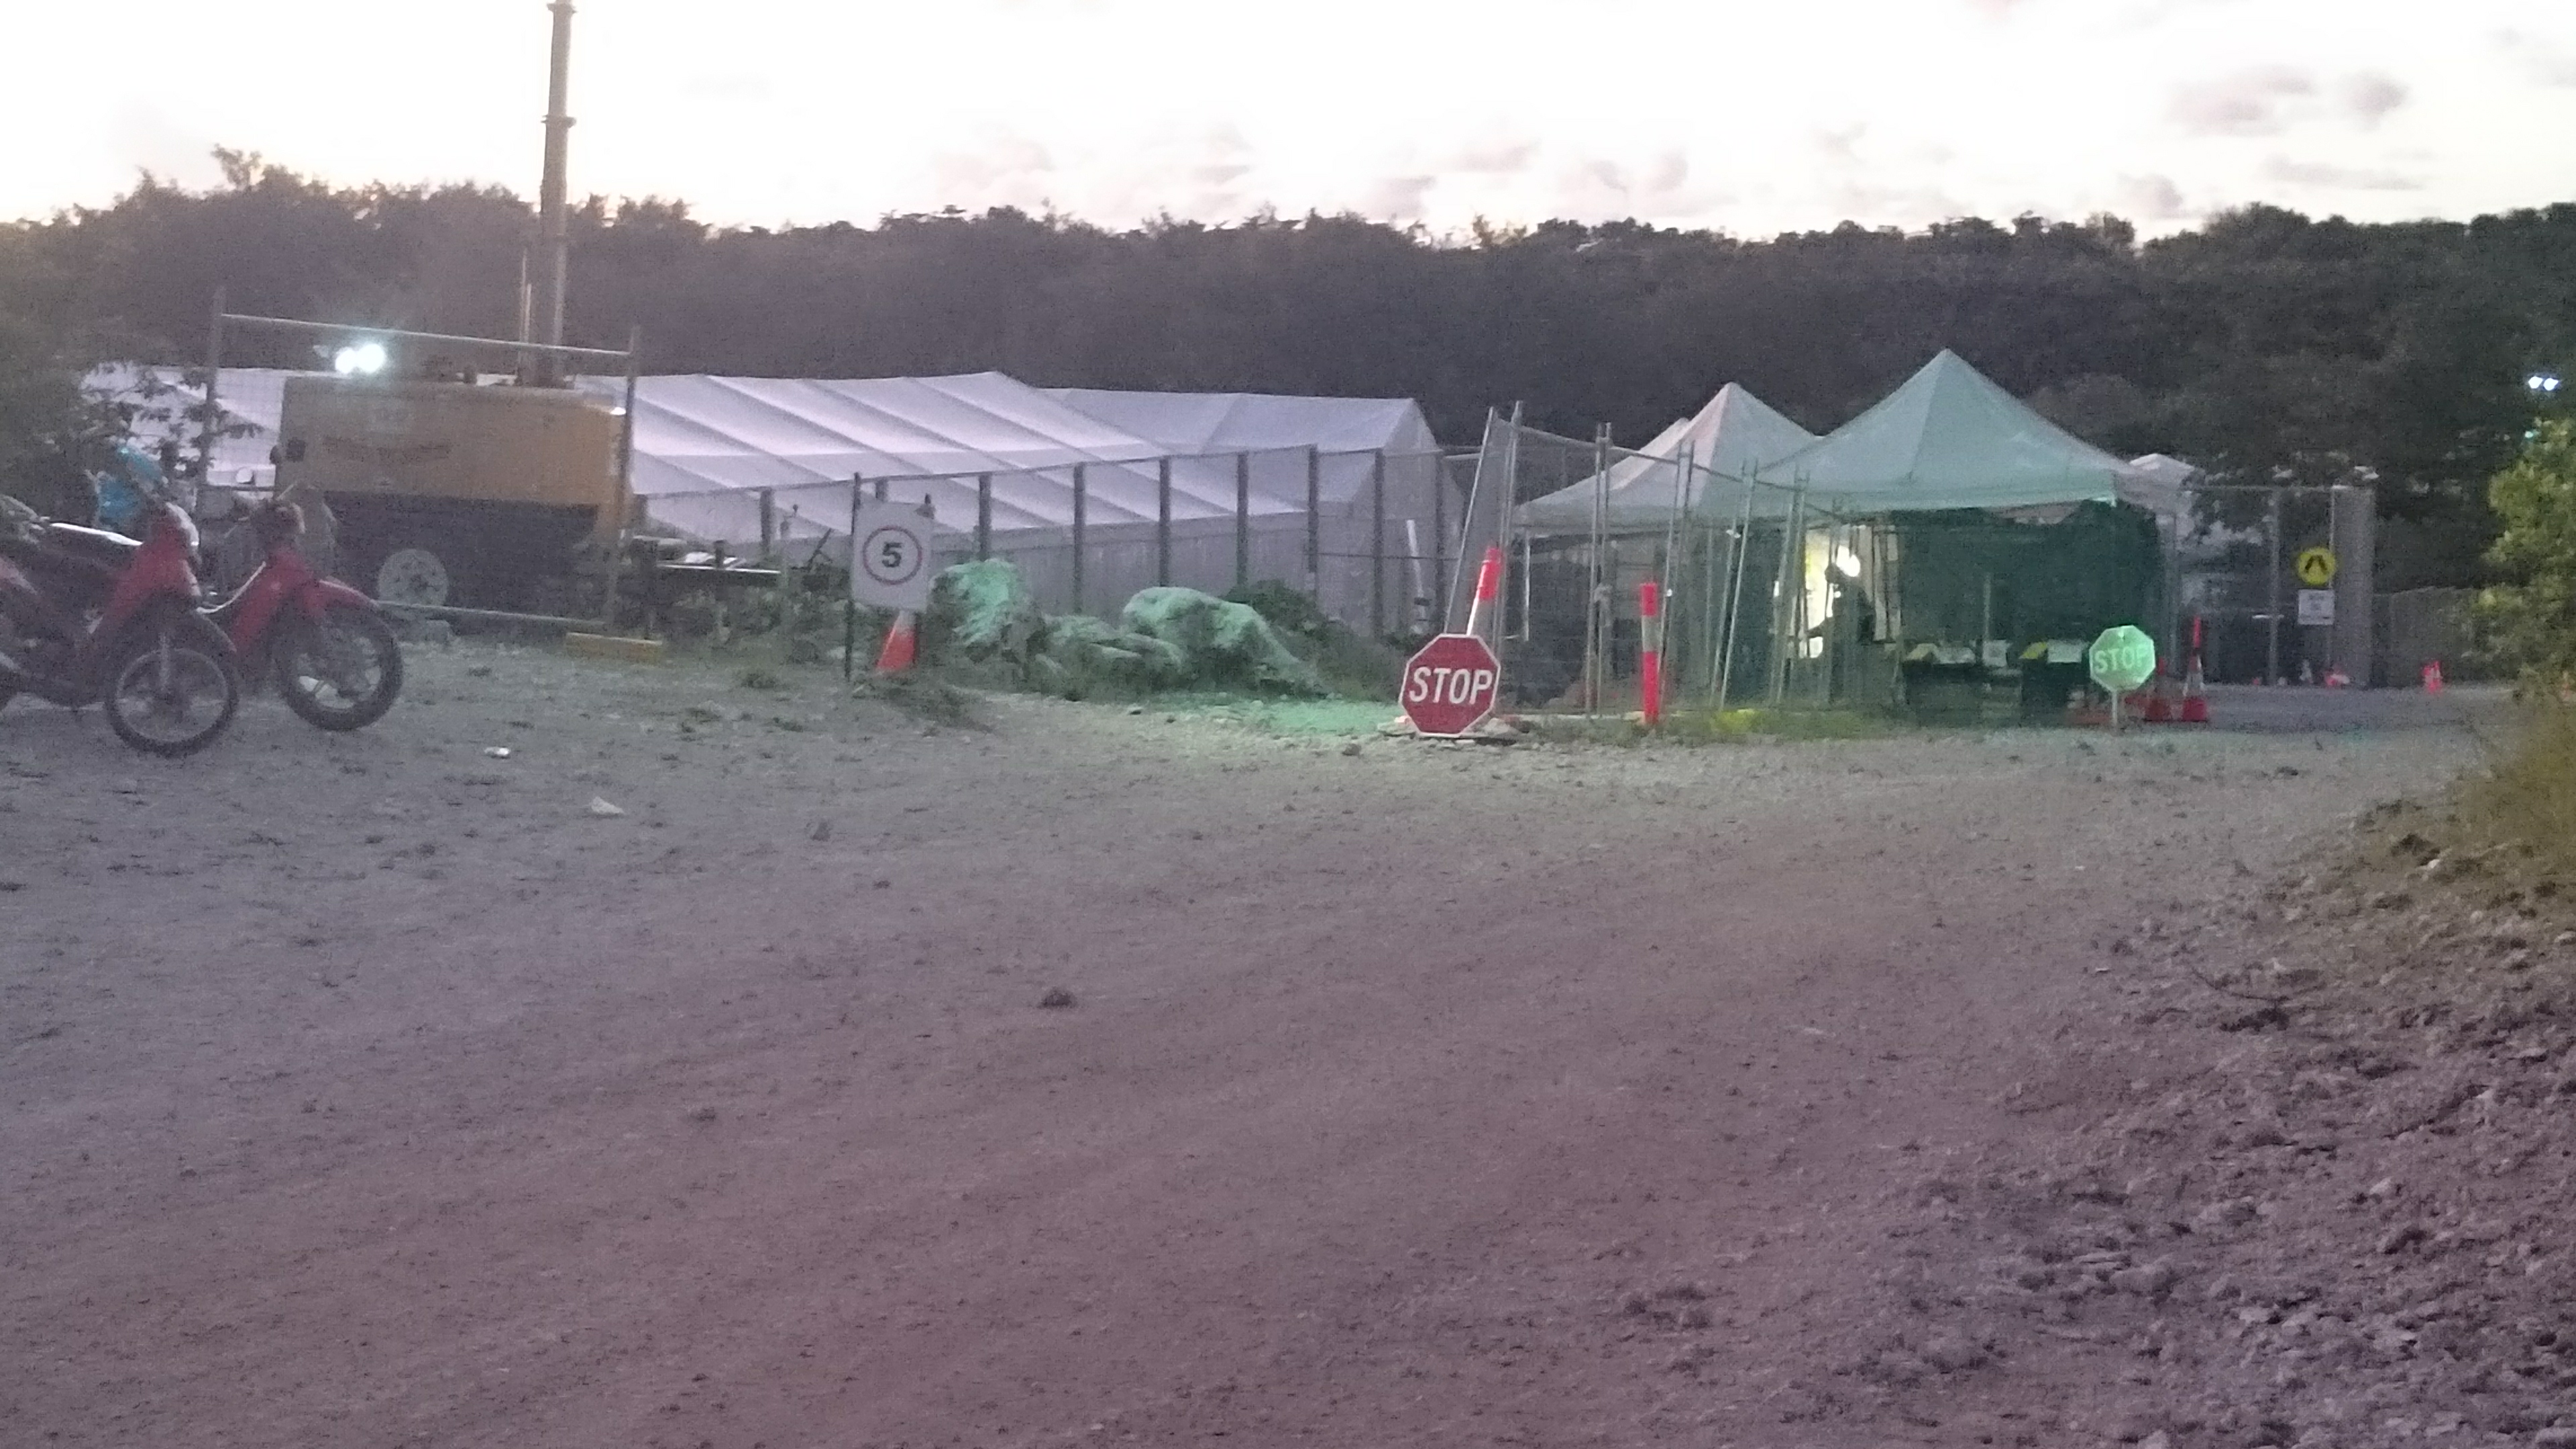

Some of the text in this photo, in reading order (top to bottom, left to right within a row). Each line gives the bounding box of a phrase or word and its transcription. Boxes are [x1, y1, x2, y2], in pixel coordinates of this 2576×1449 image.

[881, 542, 902, 568] 5
[2094, 643, 2147, 674] STOP
[1409, 666, 1493, 704] STOP
